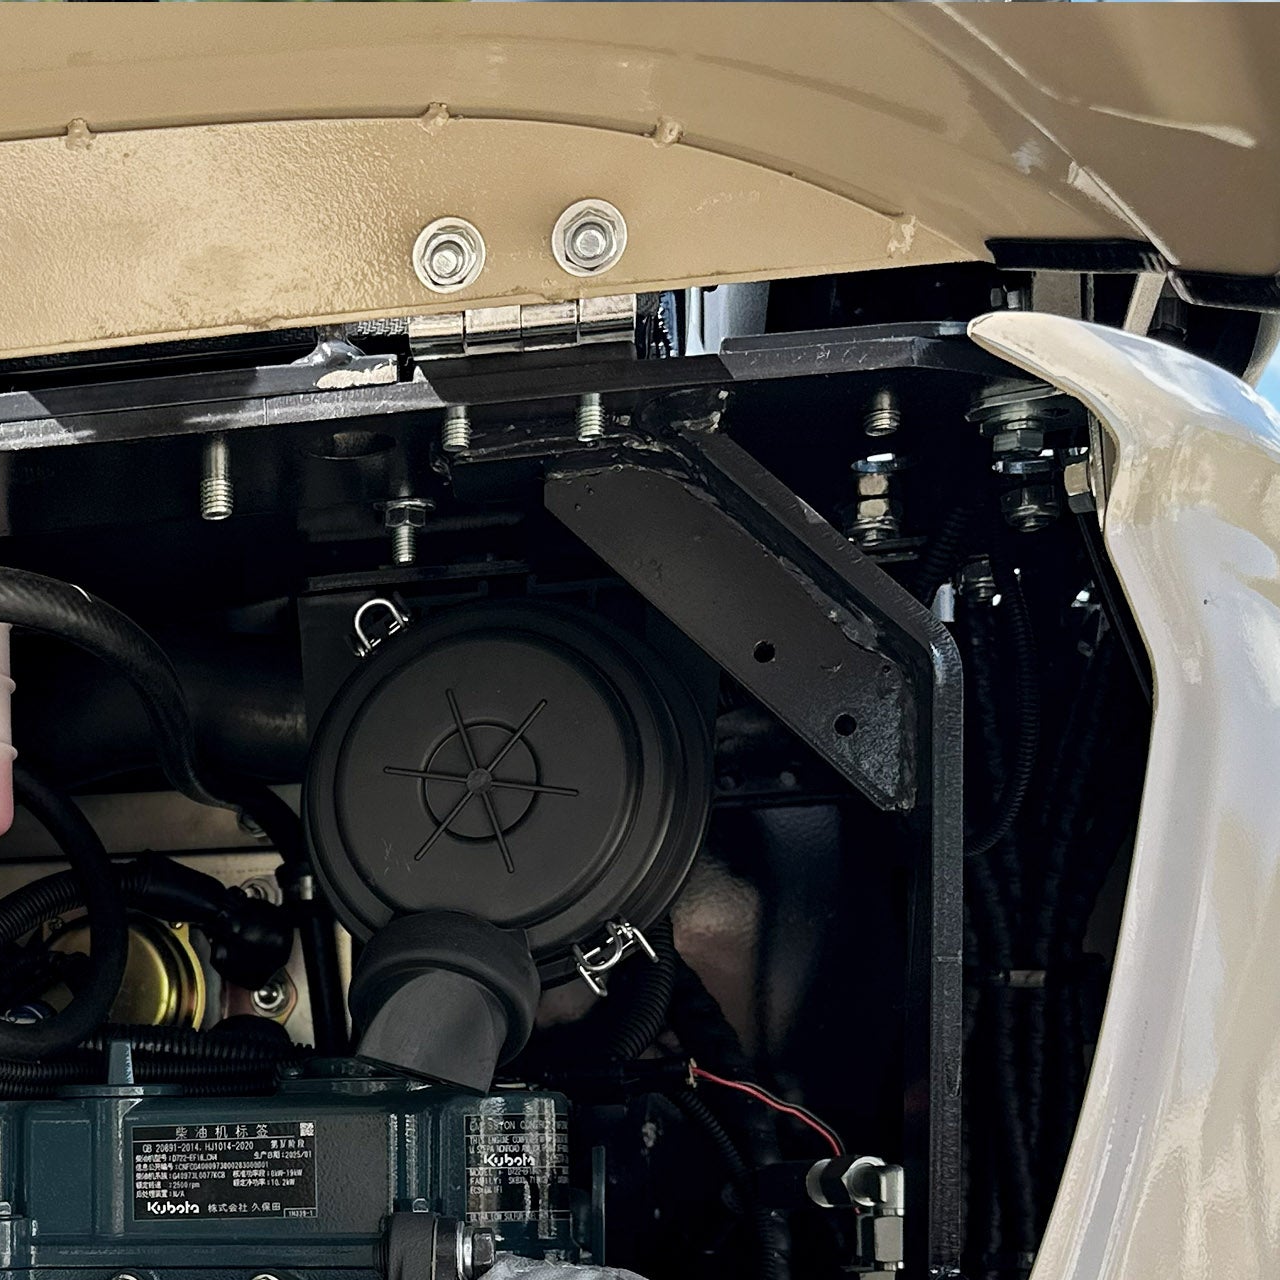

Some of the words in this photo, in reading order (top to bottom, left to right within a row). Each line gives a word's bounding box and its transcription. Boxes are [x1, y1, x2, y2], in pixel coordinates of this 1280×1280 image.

[175, 1123, 269, 1141] 柴油机标签
[483, 1152, 535, 1167] Kubota
[147, 1200, 200, 1215] Kubota
